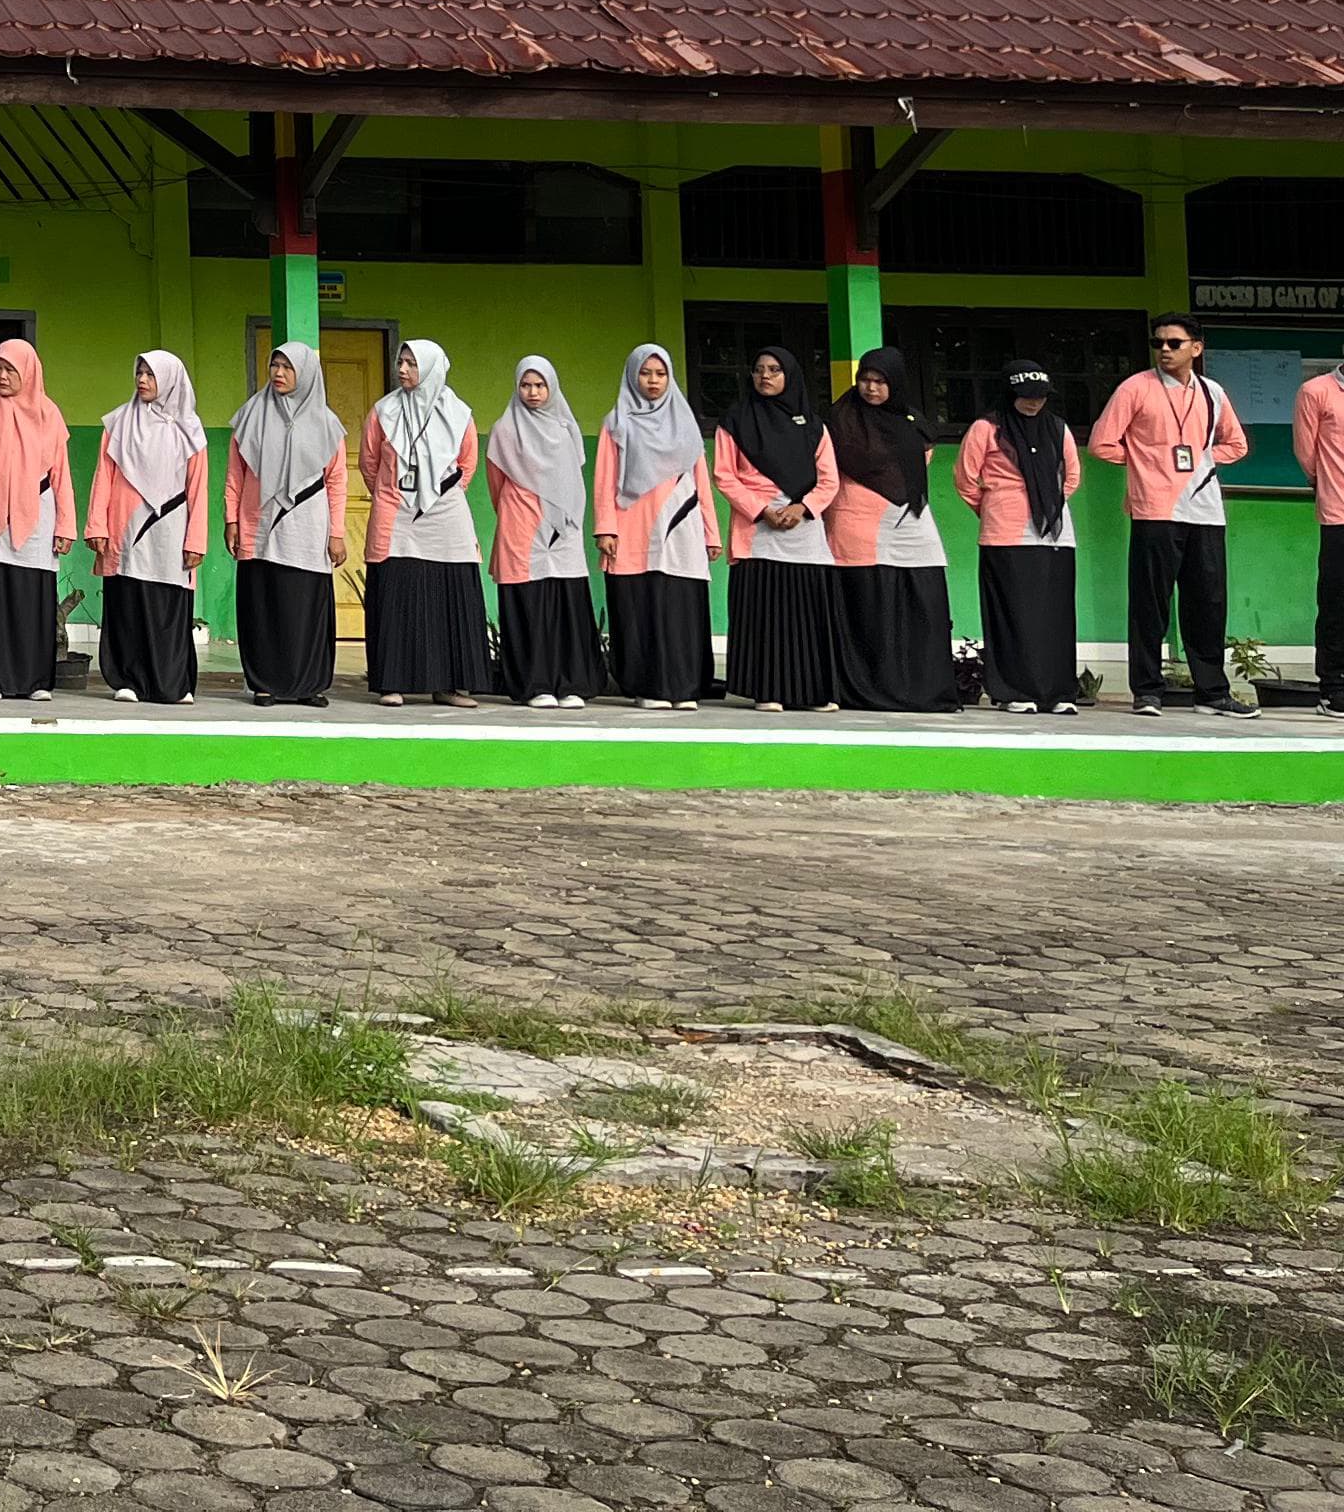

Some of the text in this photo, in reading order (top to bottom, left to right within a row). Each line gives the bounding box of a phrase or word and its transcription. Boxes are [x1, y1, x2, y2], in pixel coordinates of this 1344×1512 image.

[1195, 285, 1255, 308] SUCCES
[1256, 286, 1273, 308] IS
[1274, 286, 1317, 309] GATE
[1318, 286, 1339, 309] OF
